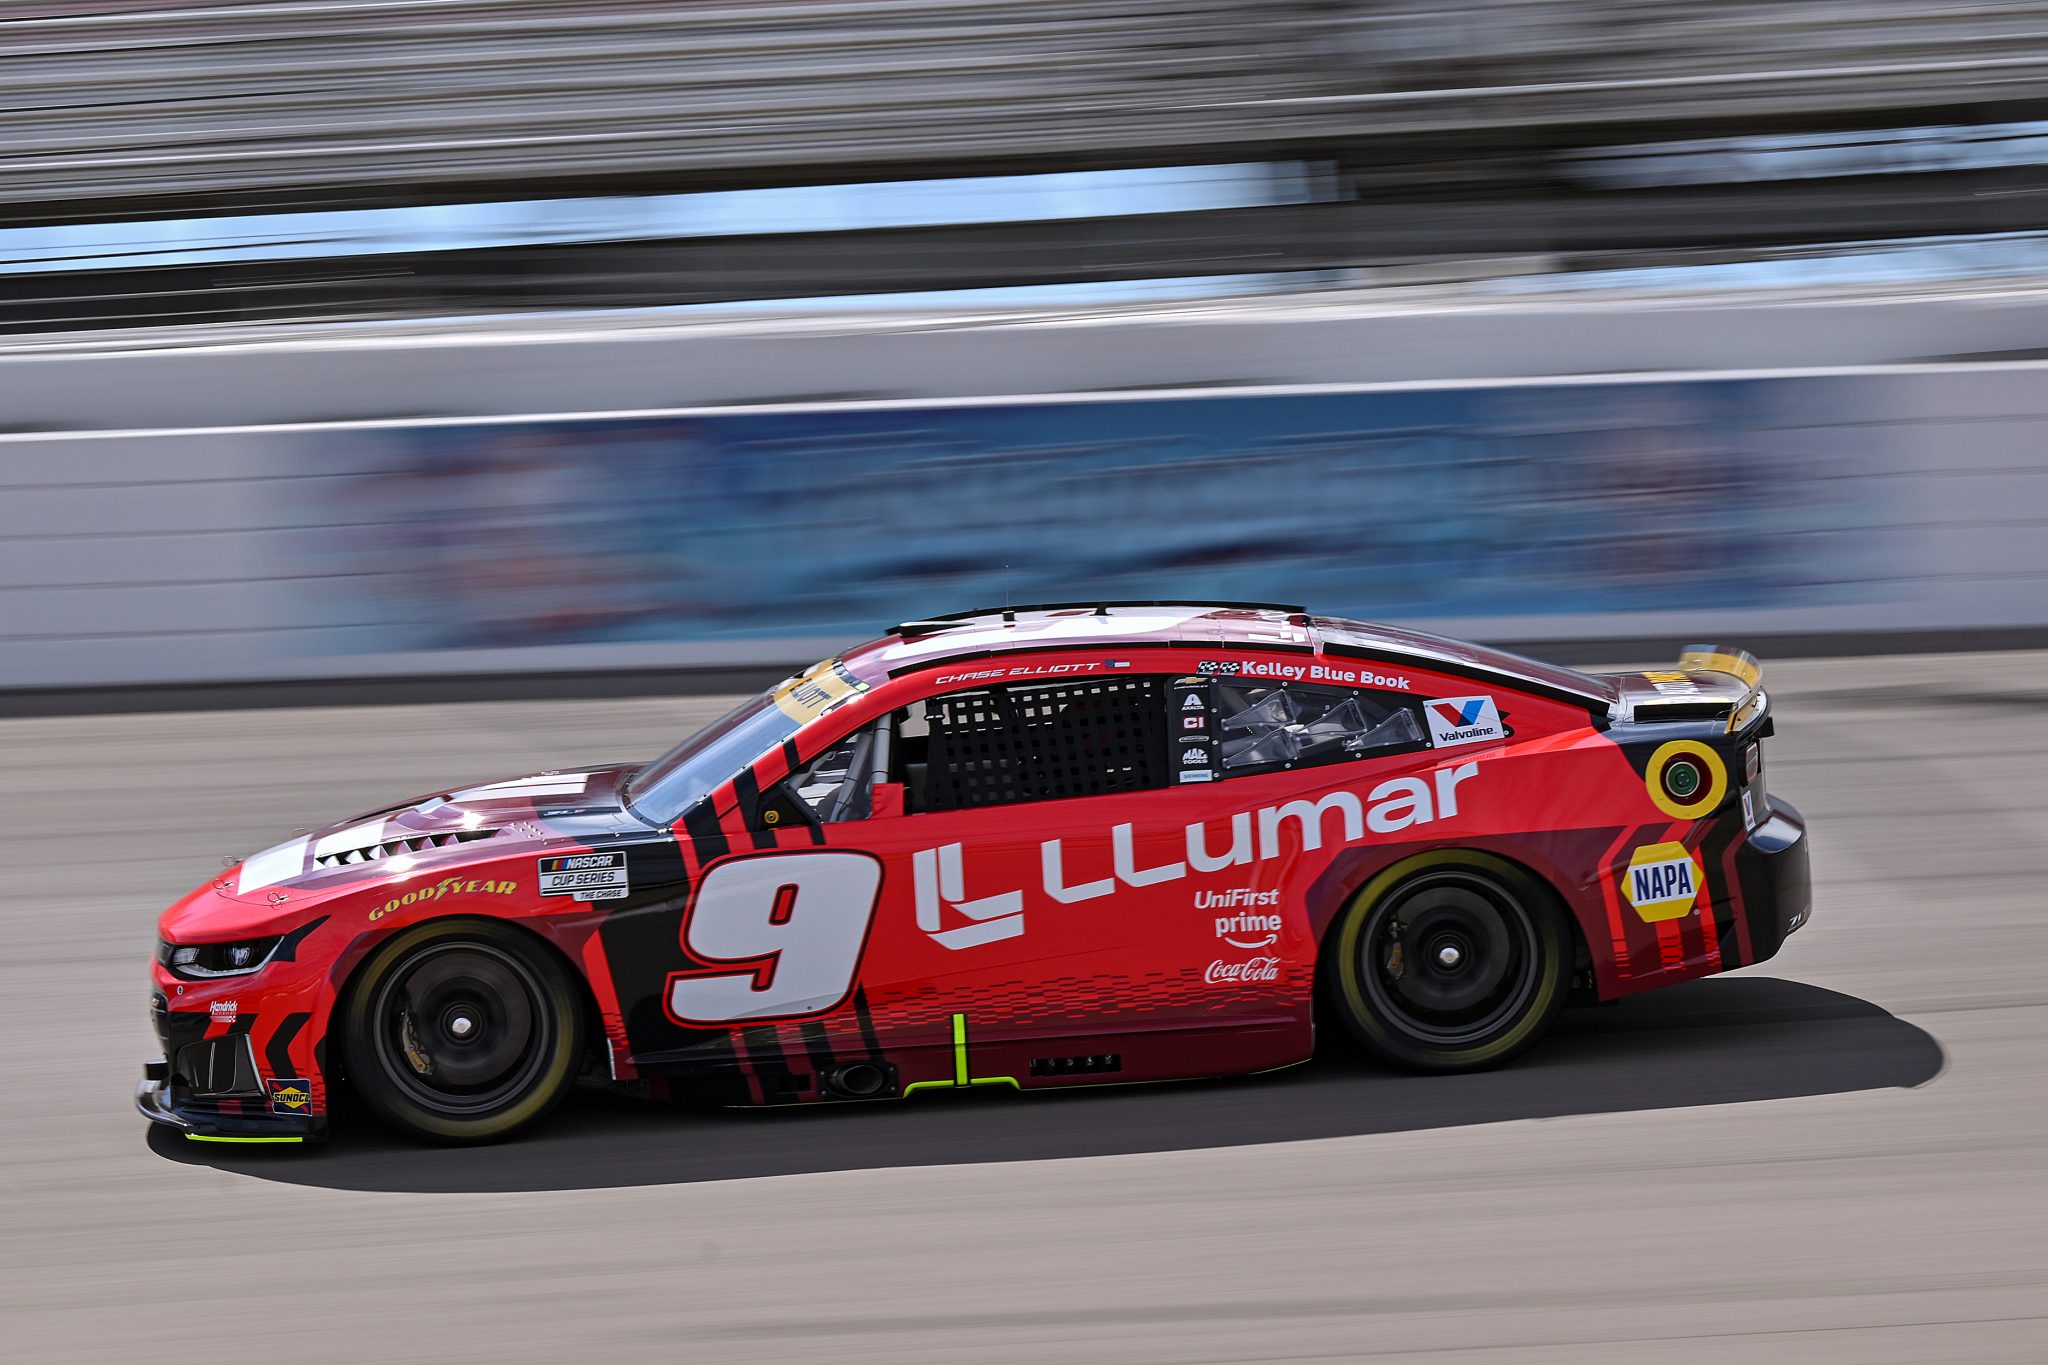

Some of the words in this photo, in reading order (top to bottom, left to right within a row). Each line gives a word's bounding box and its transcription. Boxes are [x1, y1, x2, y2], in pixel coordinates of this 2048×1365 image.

[935, 669, 1006, 684] CHASE
[1008, 663, 1101, 675] ELLIOTT
[1242, 661, 1306, 680] Kelley
[1310, 665, 1356, 682] Blue
[1360, 671, 1411, 690] Book
[1439, 728, 1494, 741] Valvoline
[1040, 761, 1479, 904] LLumar
[566, 856, 614, 869] NASCAR
[552, 874, 575, 887] CUP
[576, 872, 615, 884] SERIES
[1634, 862, 1692, 901] NAPA
[368, 876, 518, 922] GOODYEAR
[580, 891, 595, 899] THE
[596, 889, 622, 898] CHASE
[1194, 888, 1280, 909] UniFirst
[1215, 911, 1282, 938] prime
[664, 850, 885, 1029] 9
[1204, 956, 1281, 984] Coca-Cola
[210, 1001, 238, 1015] Hendrick
